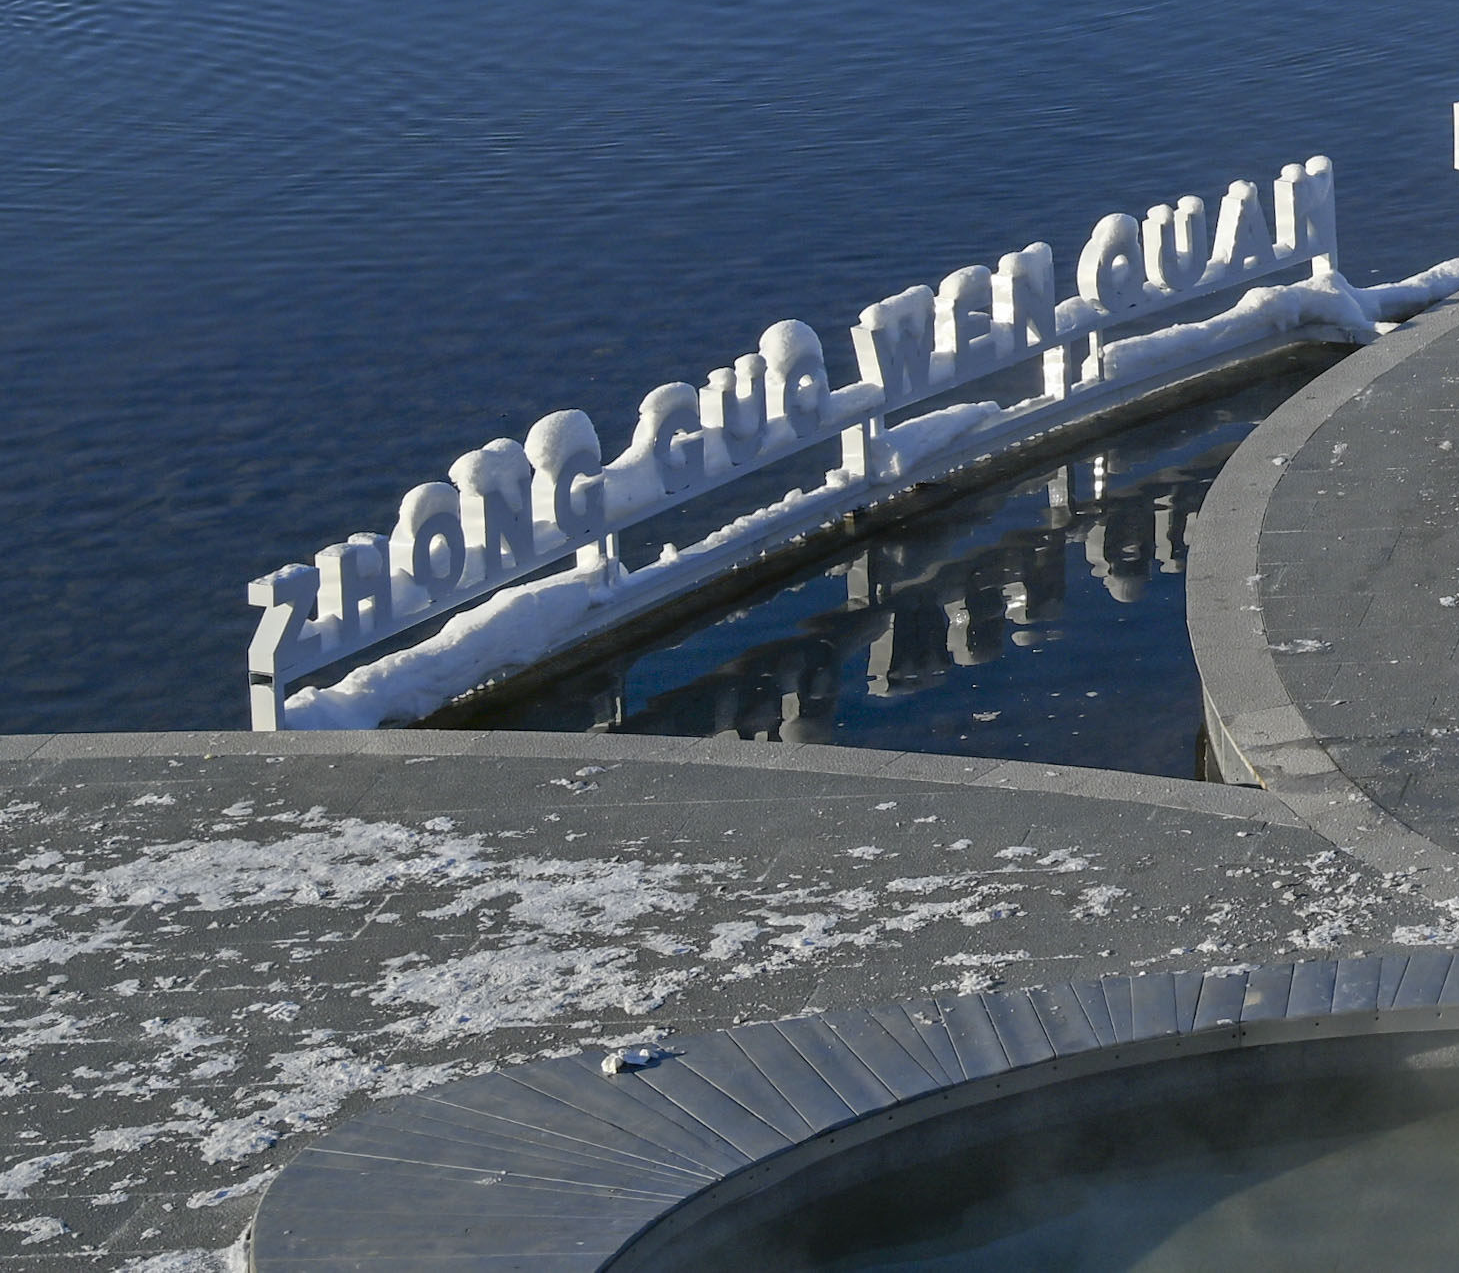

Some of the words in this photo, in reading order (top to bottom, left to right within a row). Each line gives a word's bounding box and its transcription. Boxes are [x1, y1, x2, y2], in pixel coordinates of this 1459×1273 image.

[247, 408, 606, 668] ZHONG
[850, 241, 1056, 401] WEN
[1077, 155, 1337, 314] QUAN
